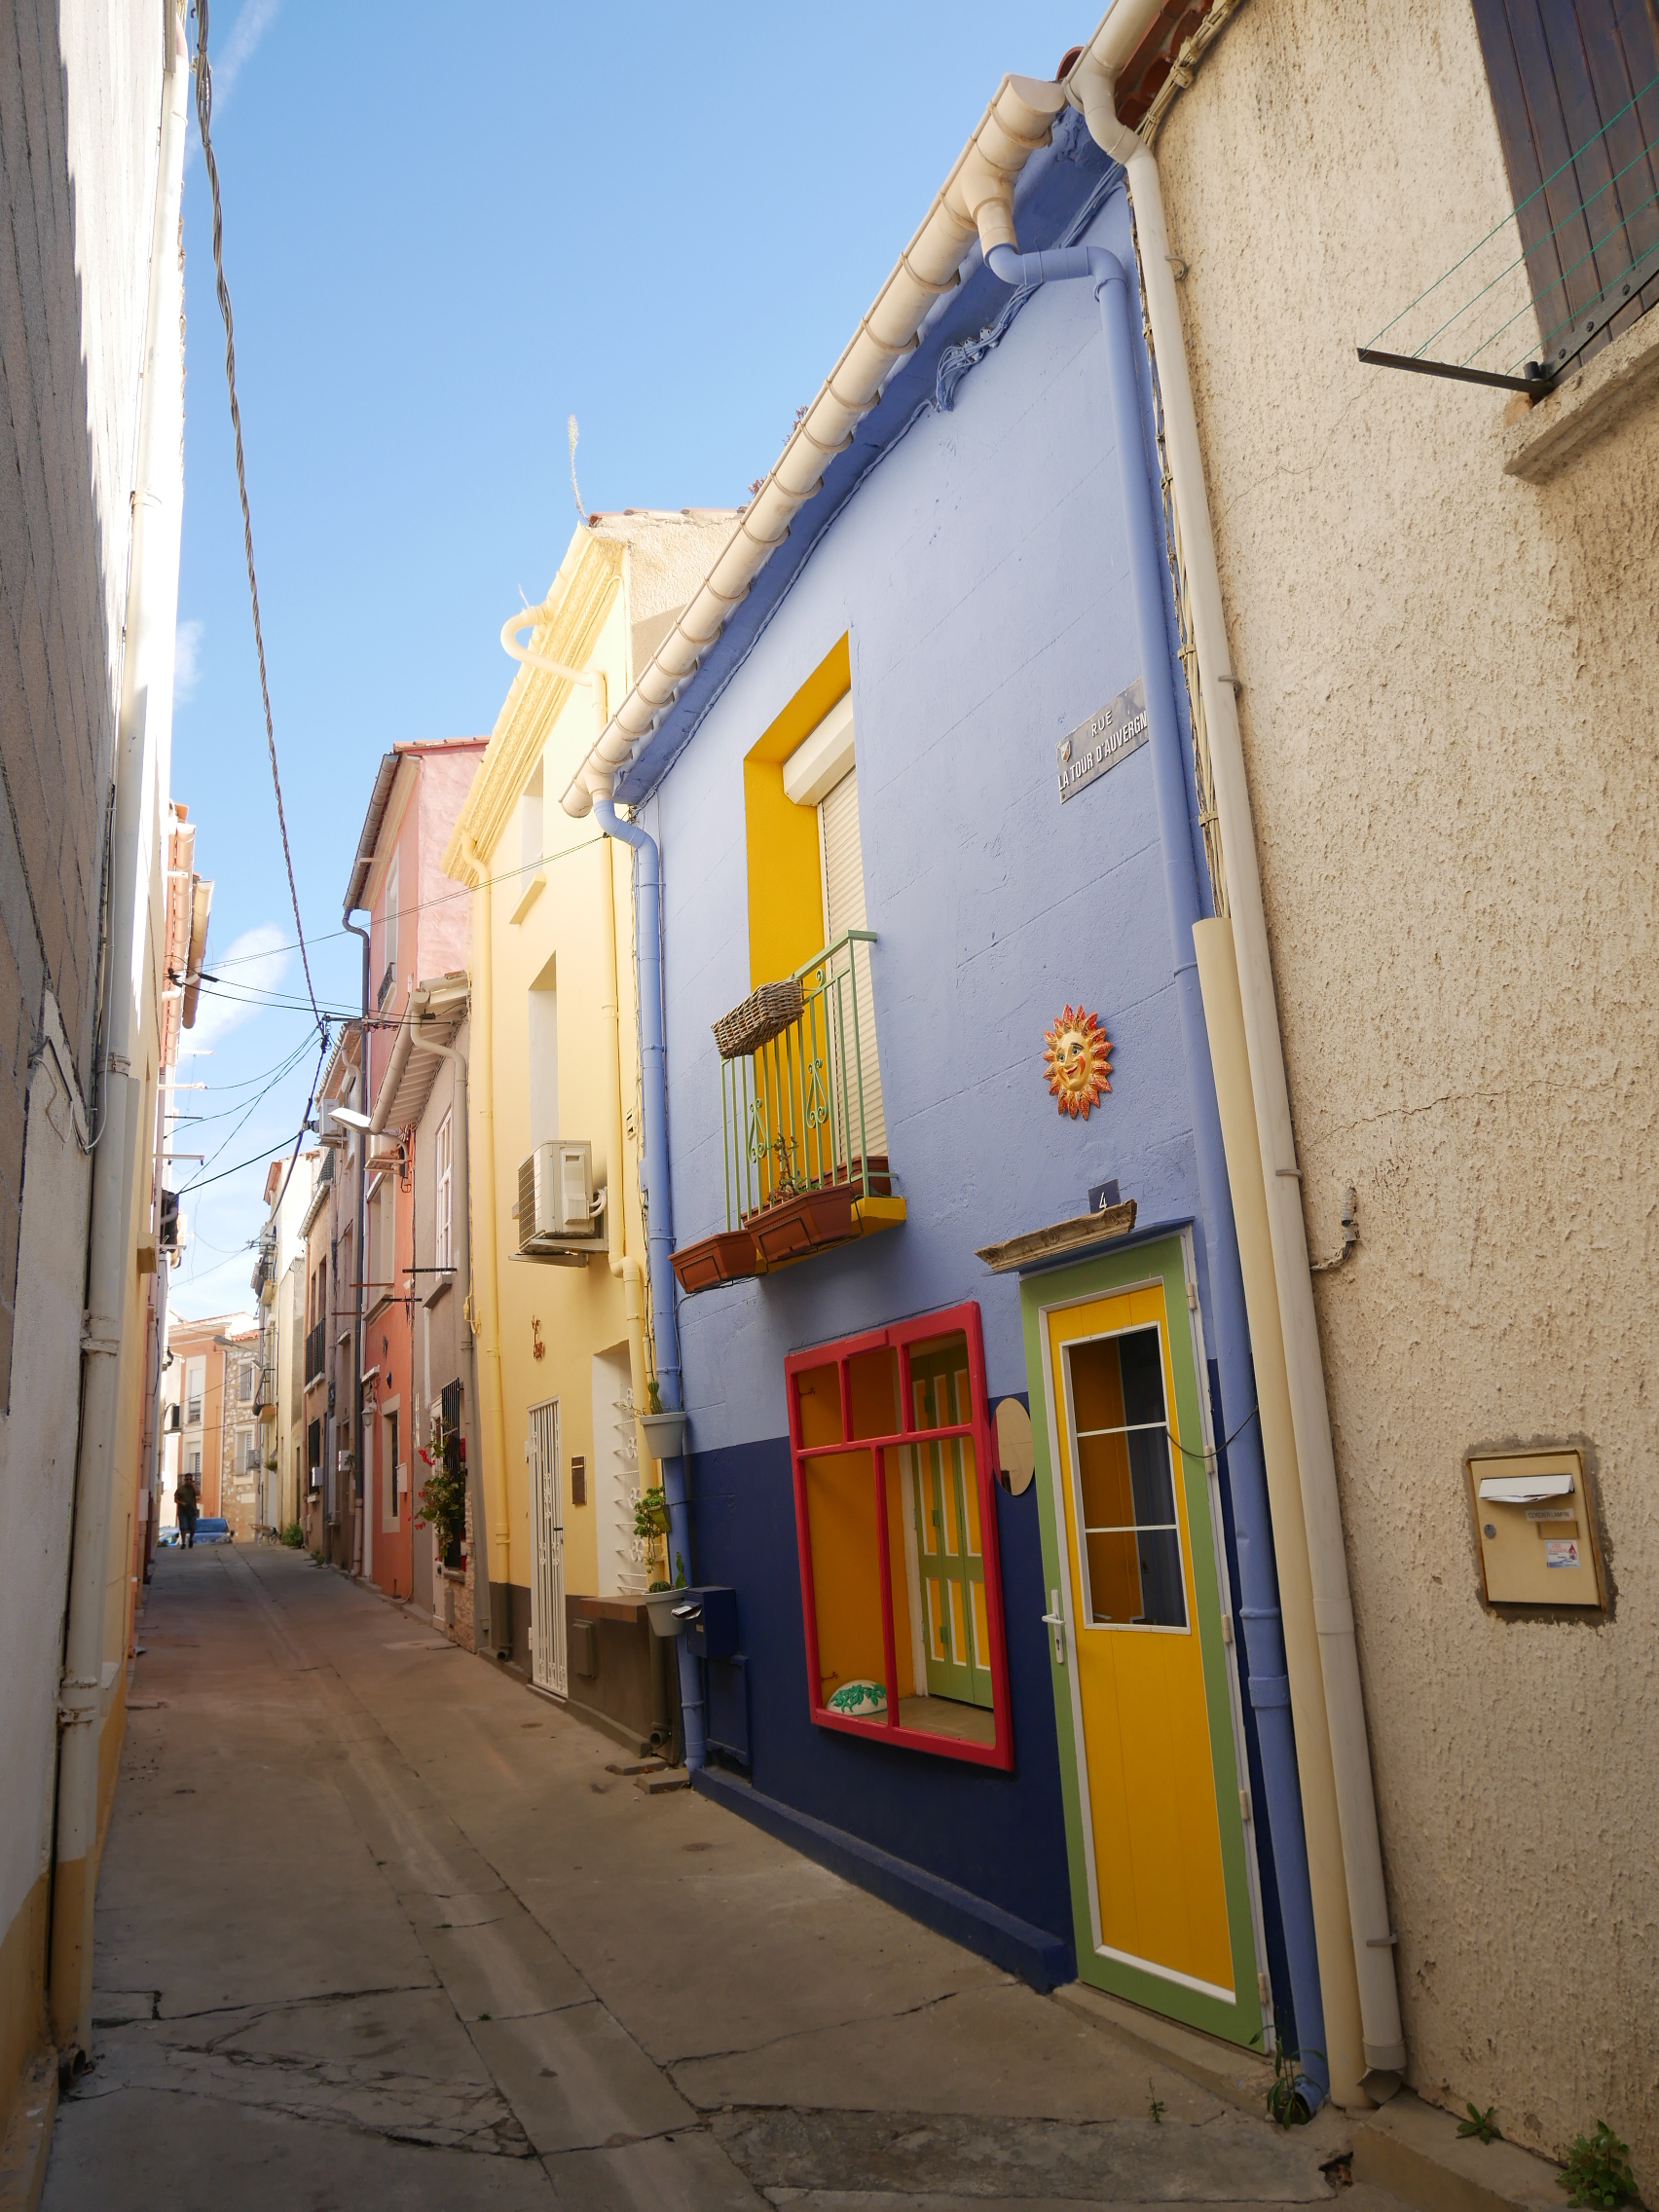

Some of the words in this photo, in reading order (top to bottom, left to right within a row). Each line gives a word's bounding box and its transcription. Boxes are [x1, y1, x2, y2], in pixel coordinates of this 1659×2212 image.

[1091, 711, 1112, 737] RUE
[1058, 771, 1069, 792] LA
[1070, 753, 1093, 782] TOUR
[1096, 711, 1148, 762] D'AUVERGN
[1099, 1192, 1107, 1209] 4
